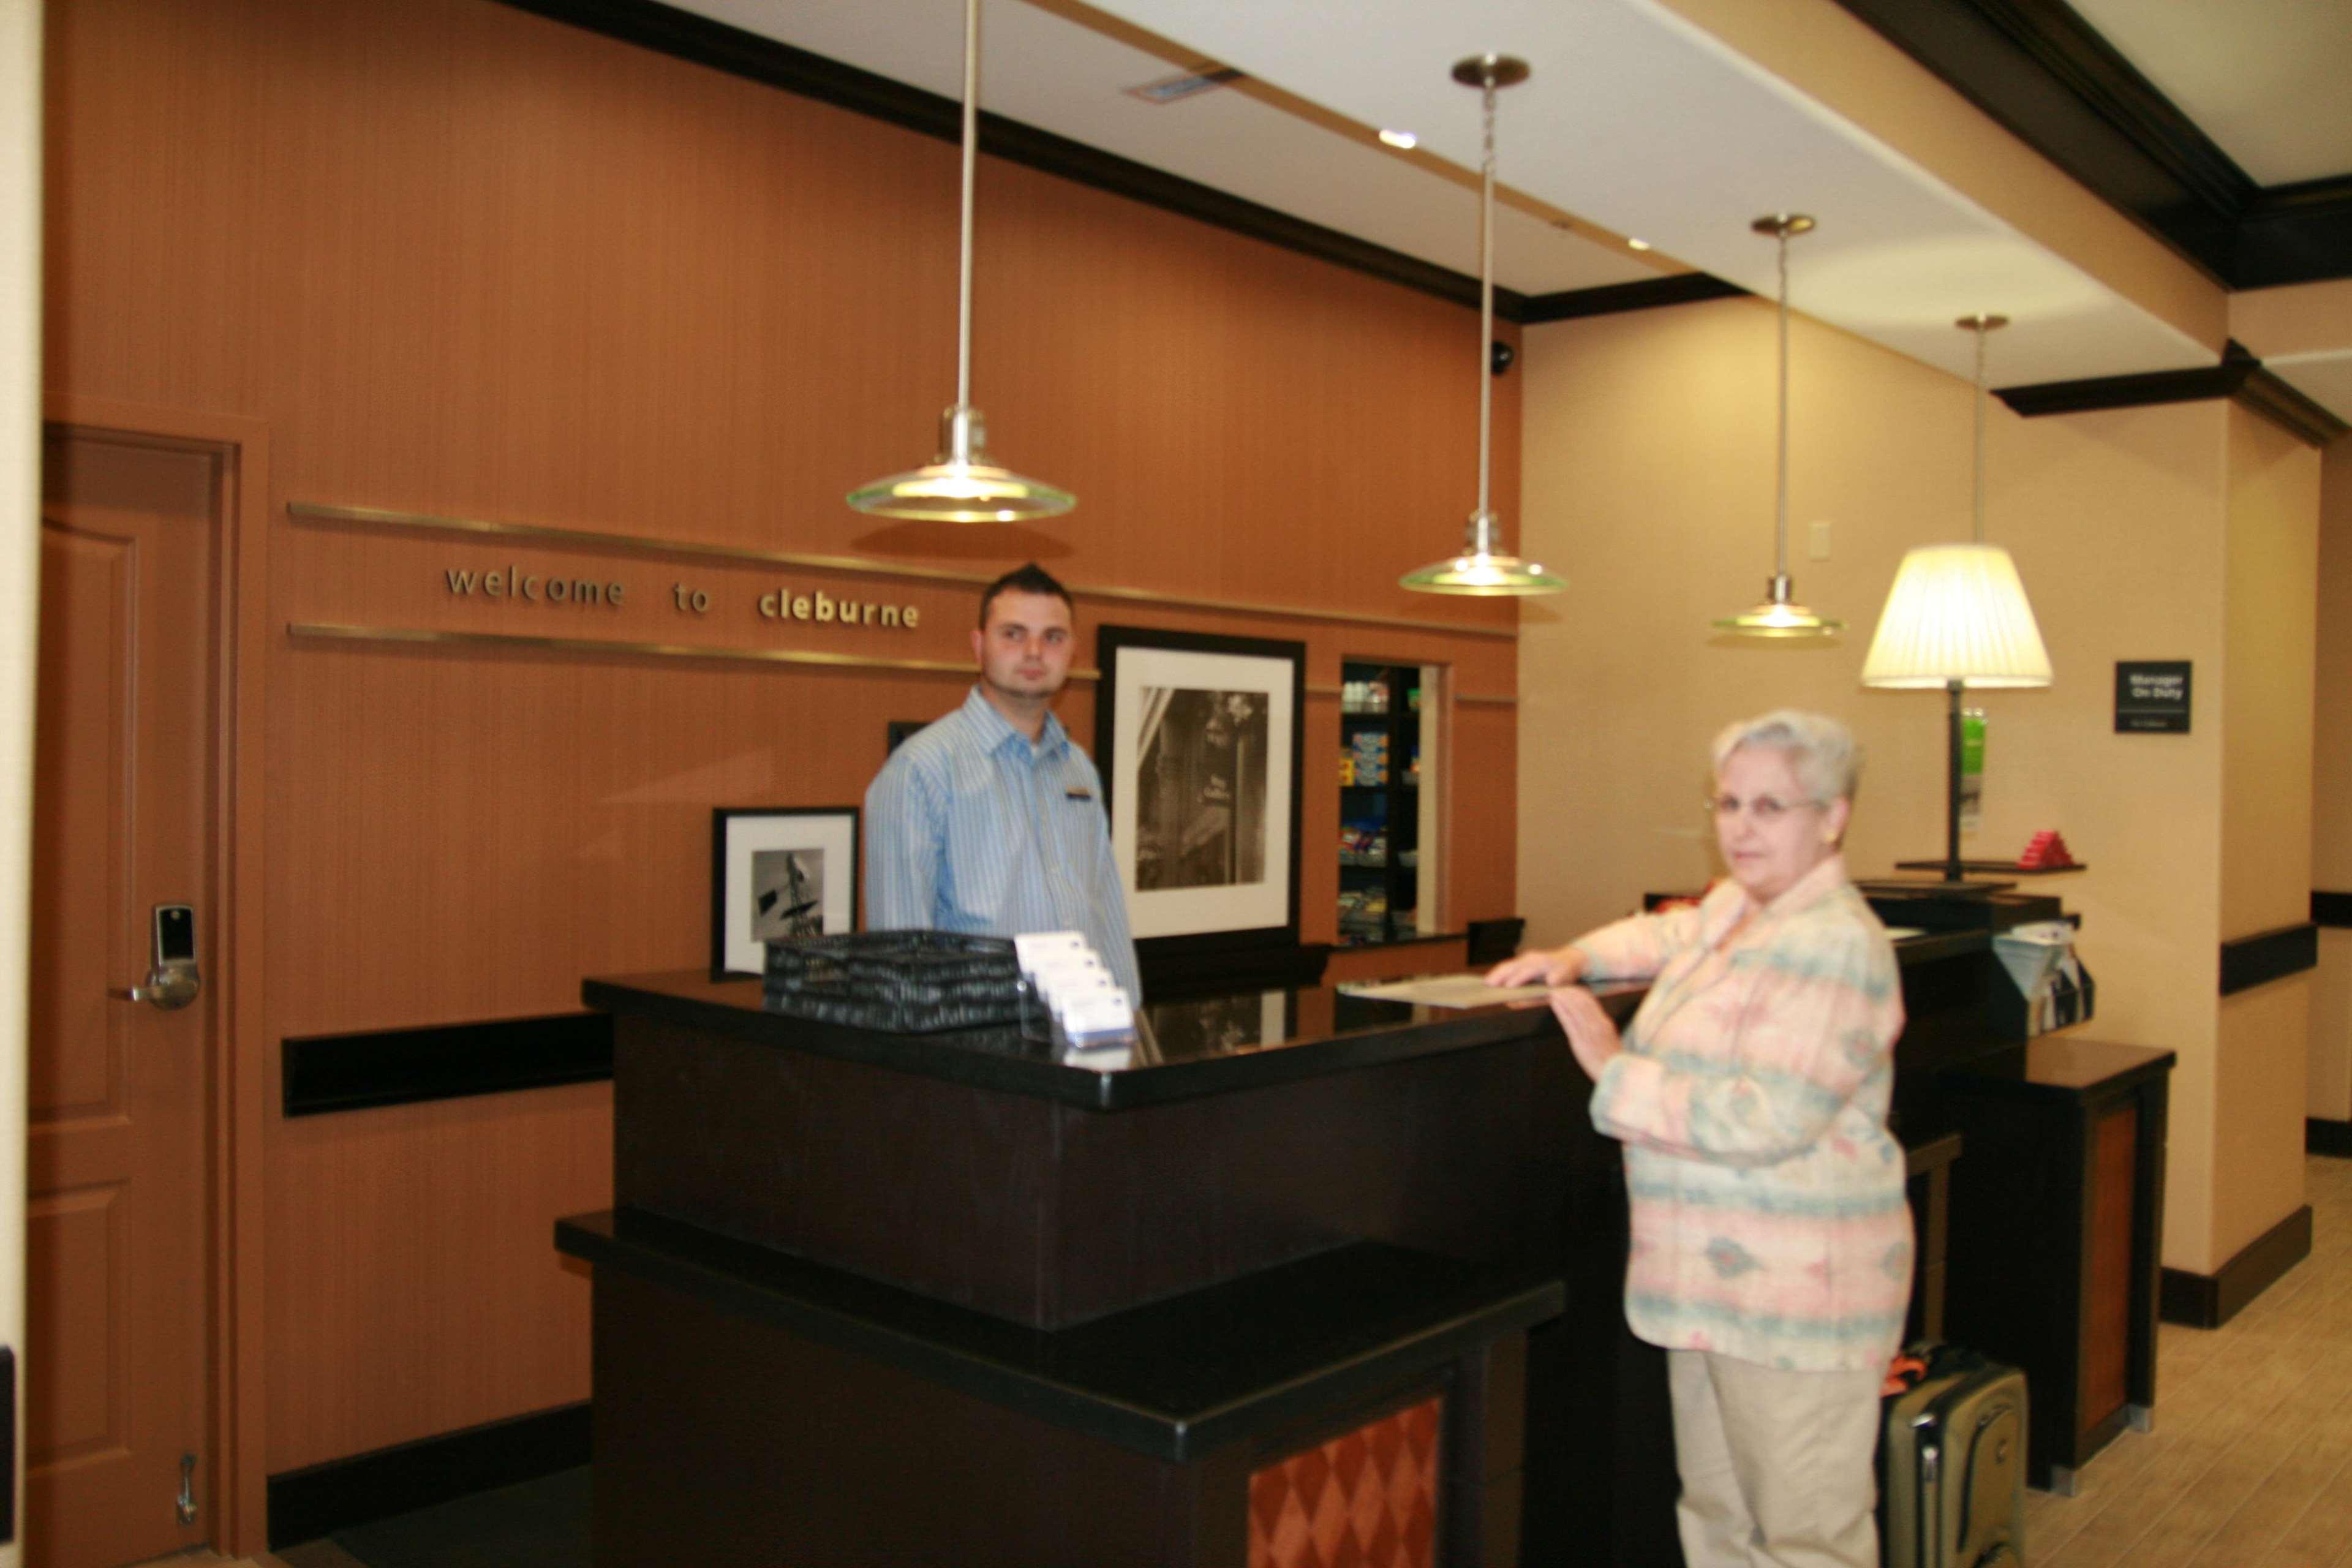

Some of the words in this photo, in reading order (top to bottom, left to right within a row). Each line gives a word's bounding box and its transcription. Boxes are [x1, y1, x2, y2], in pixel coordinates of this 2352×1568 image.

[447, 566, 626, 605] welcome
[673, 582, 710, 612] to
[760, 589, 920, 628] cleburne
